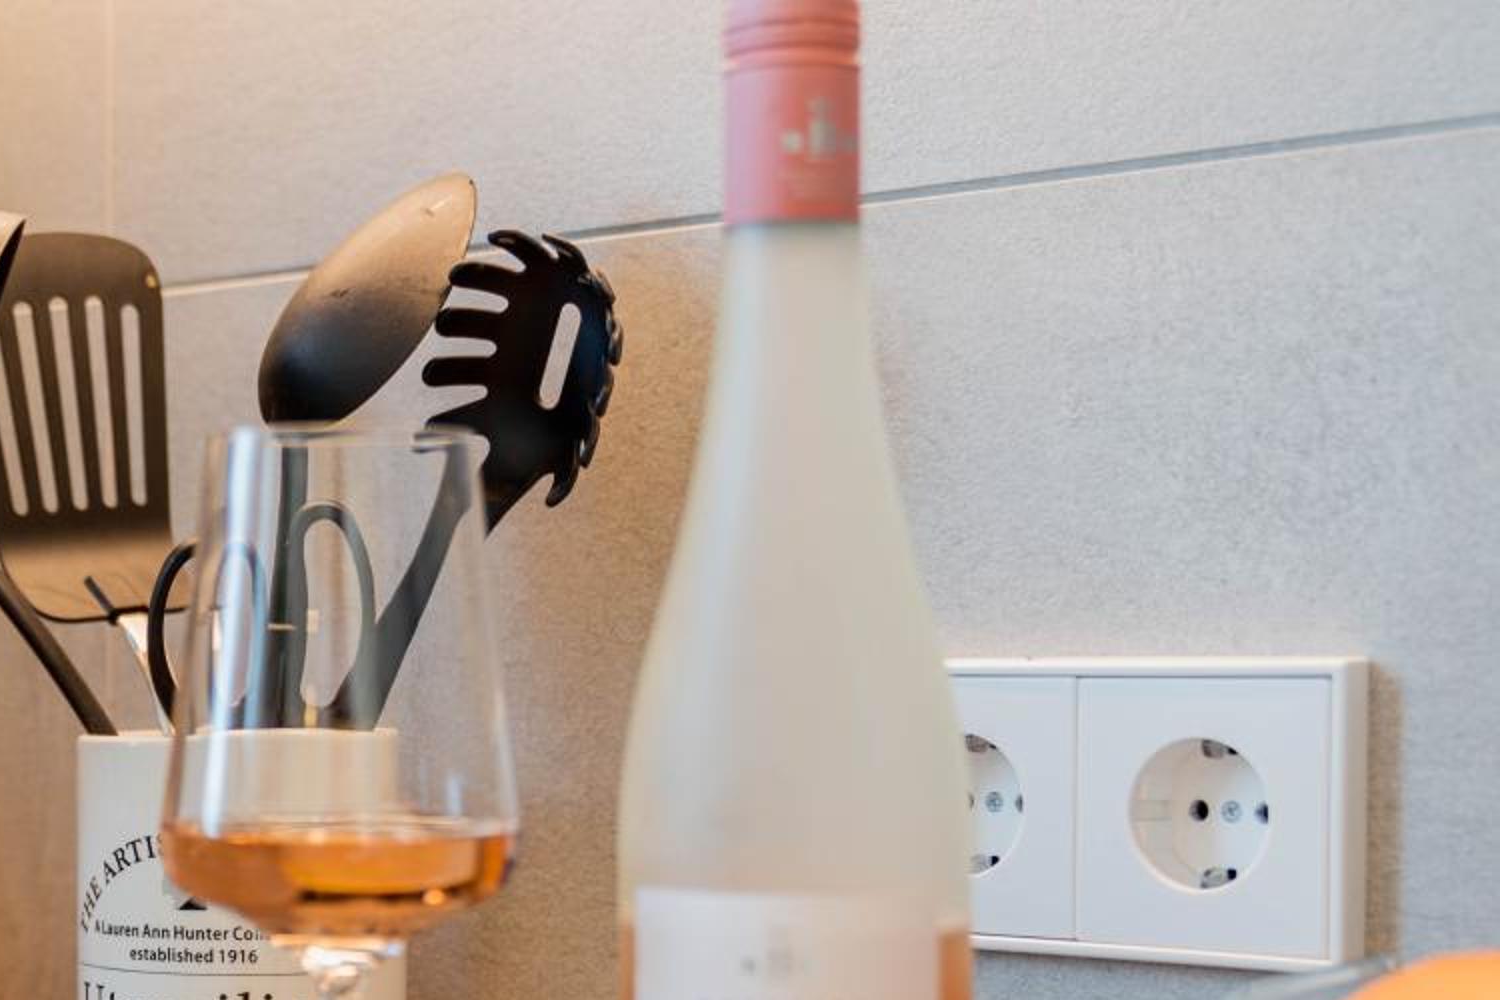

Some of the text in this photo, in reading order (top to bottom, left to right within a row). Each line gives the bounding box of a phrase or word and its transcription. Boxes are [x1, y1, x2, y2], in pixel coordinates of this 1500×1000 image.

[101, 920, 139, 938] Lauren
[142, 924, 171, 939] Ann
[173, 926, 228, 942] Hunter
[129, 947, 259, 964] established 1916
